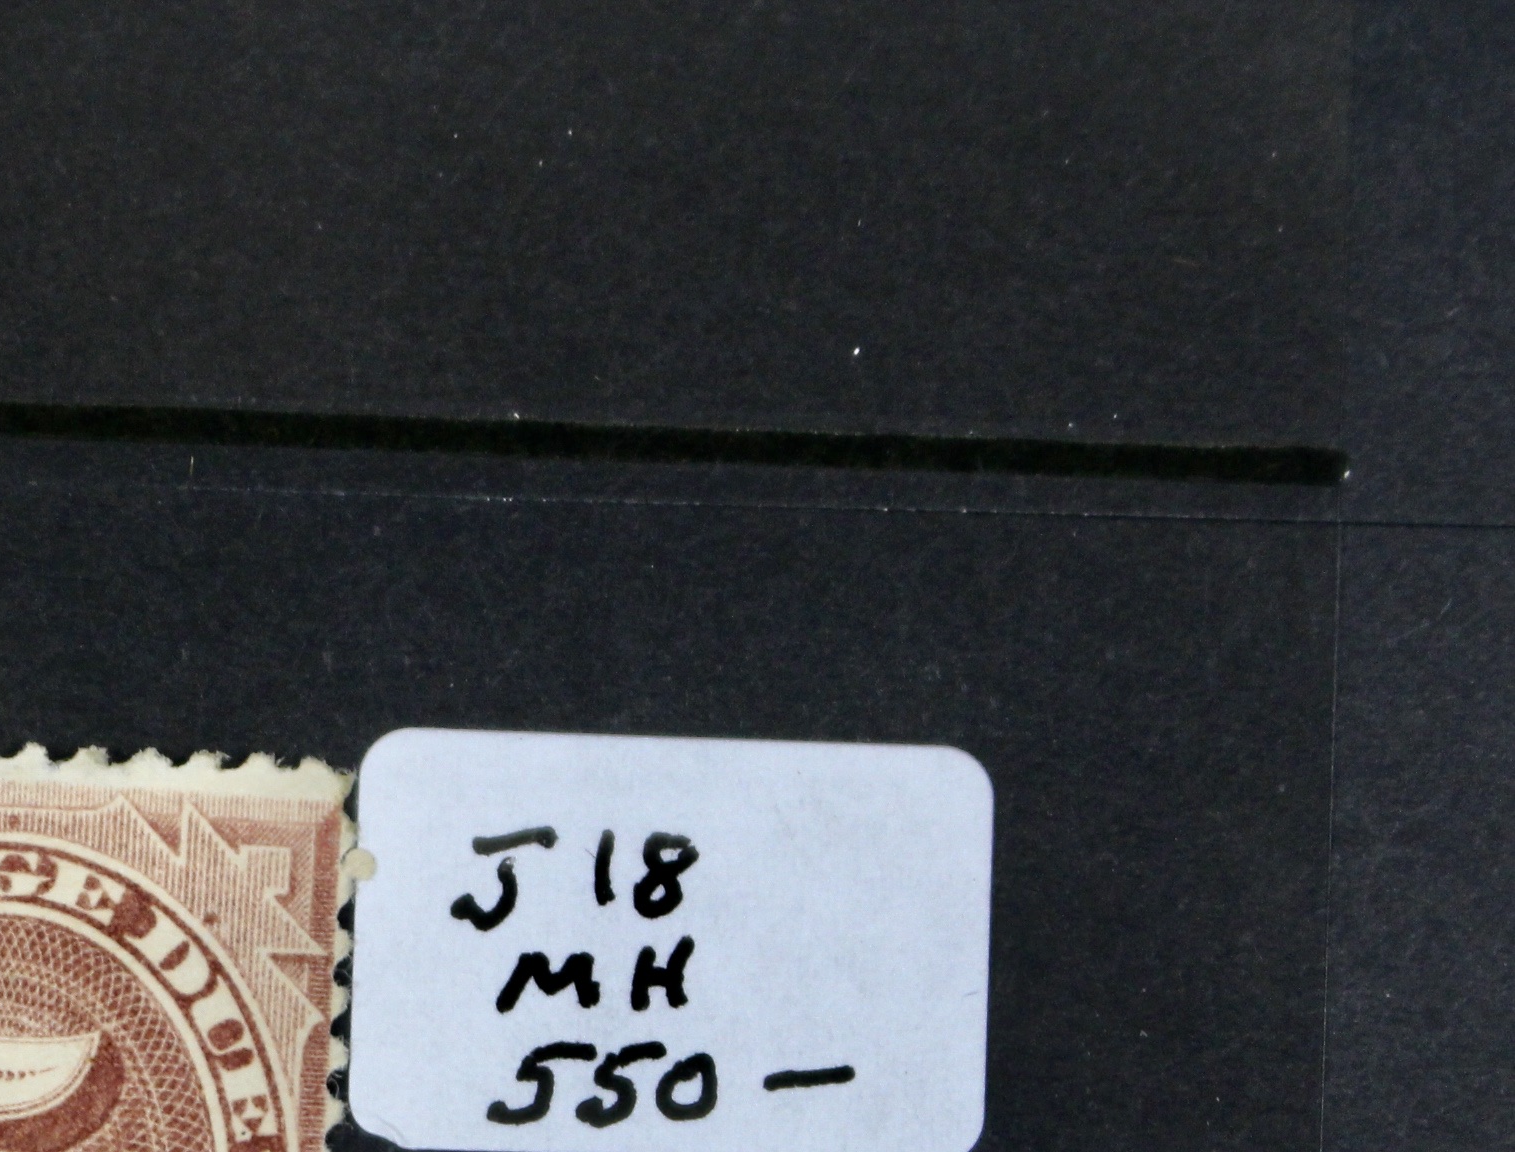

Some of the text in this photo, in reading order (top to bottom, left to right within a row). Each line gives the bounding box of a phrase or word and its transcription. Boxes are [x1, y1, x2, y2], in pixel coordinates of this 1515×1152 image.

[450, 826, 700, 931] J 18
[126, 903, 281, 1142] DUE
